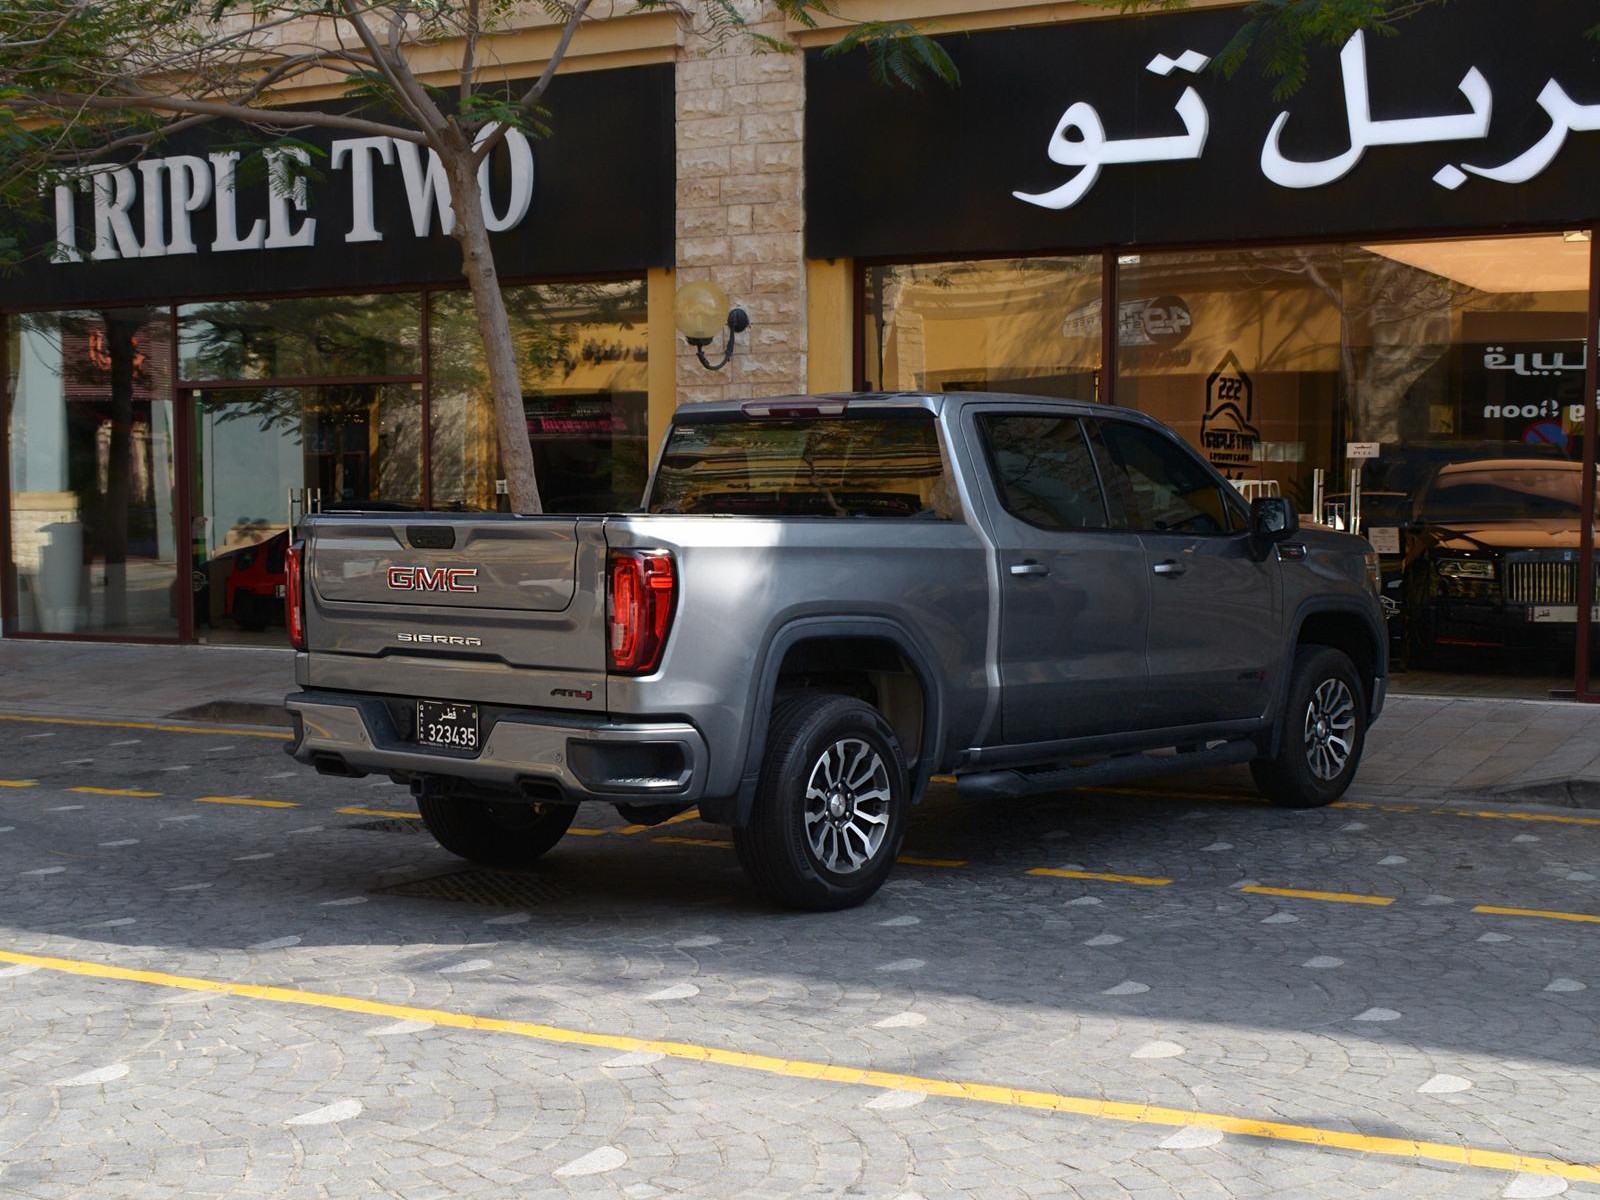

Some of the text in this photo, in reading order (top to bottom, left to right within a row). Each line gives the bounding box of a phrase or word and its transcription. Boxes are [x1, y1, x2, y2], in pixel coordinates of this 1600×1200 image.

[1012, 27, 1600, 211] ربل تو
[38, 121, 535, 264] TRIPLE TWO
[1218, 377, 1242, 400] 222
[387, 566, 478, 593] GMC
[397, 633, 482, 647] SIERRA
[550, 688, 593, 701] AT4
[438, 707, 457, 721] قطر
[428, 723, 476, 746] 323435
